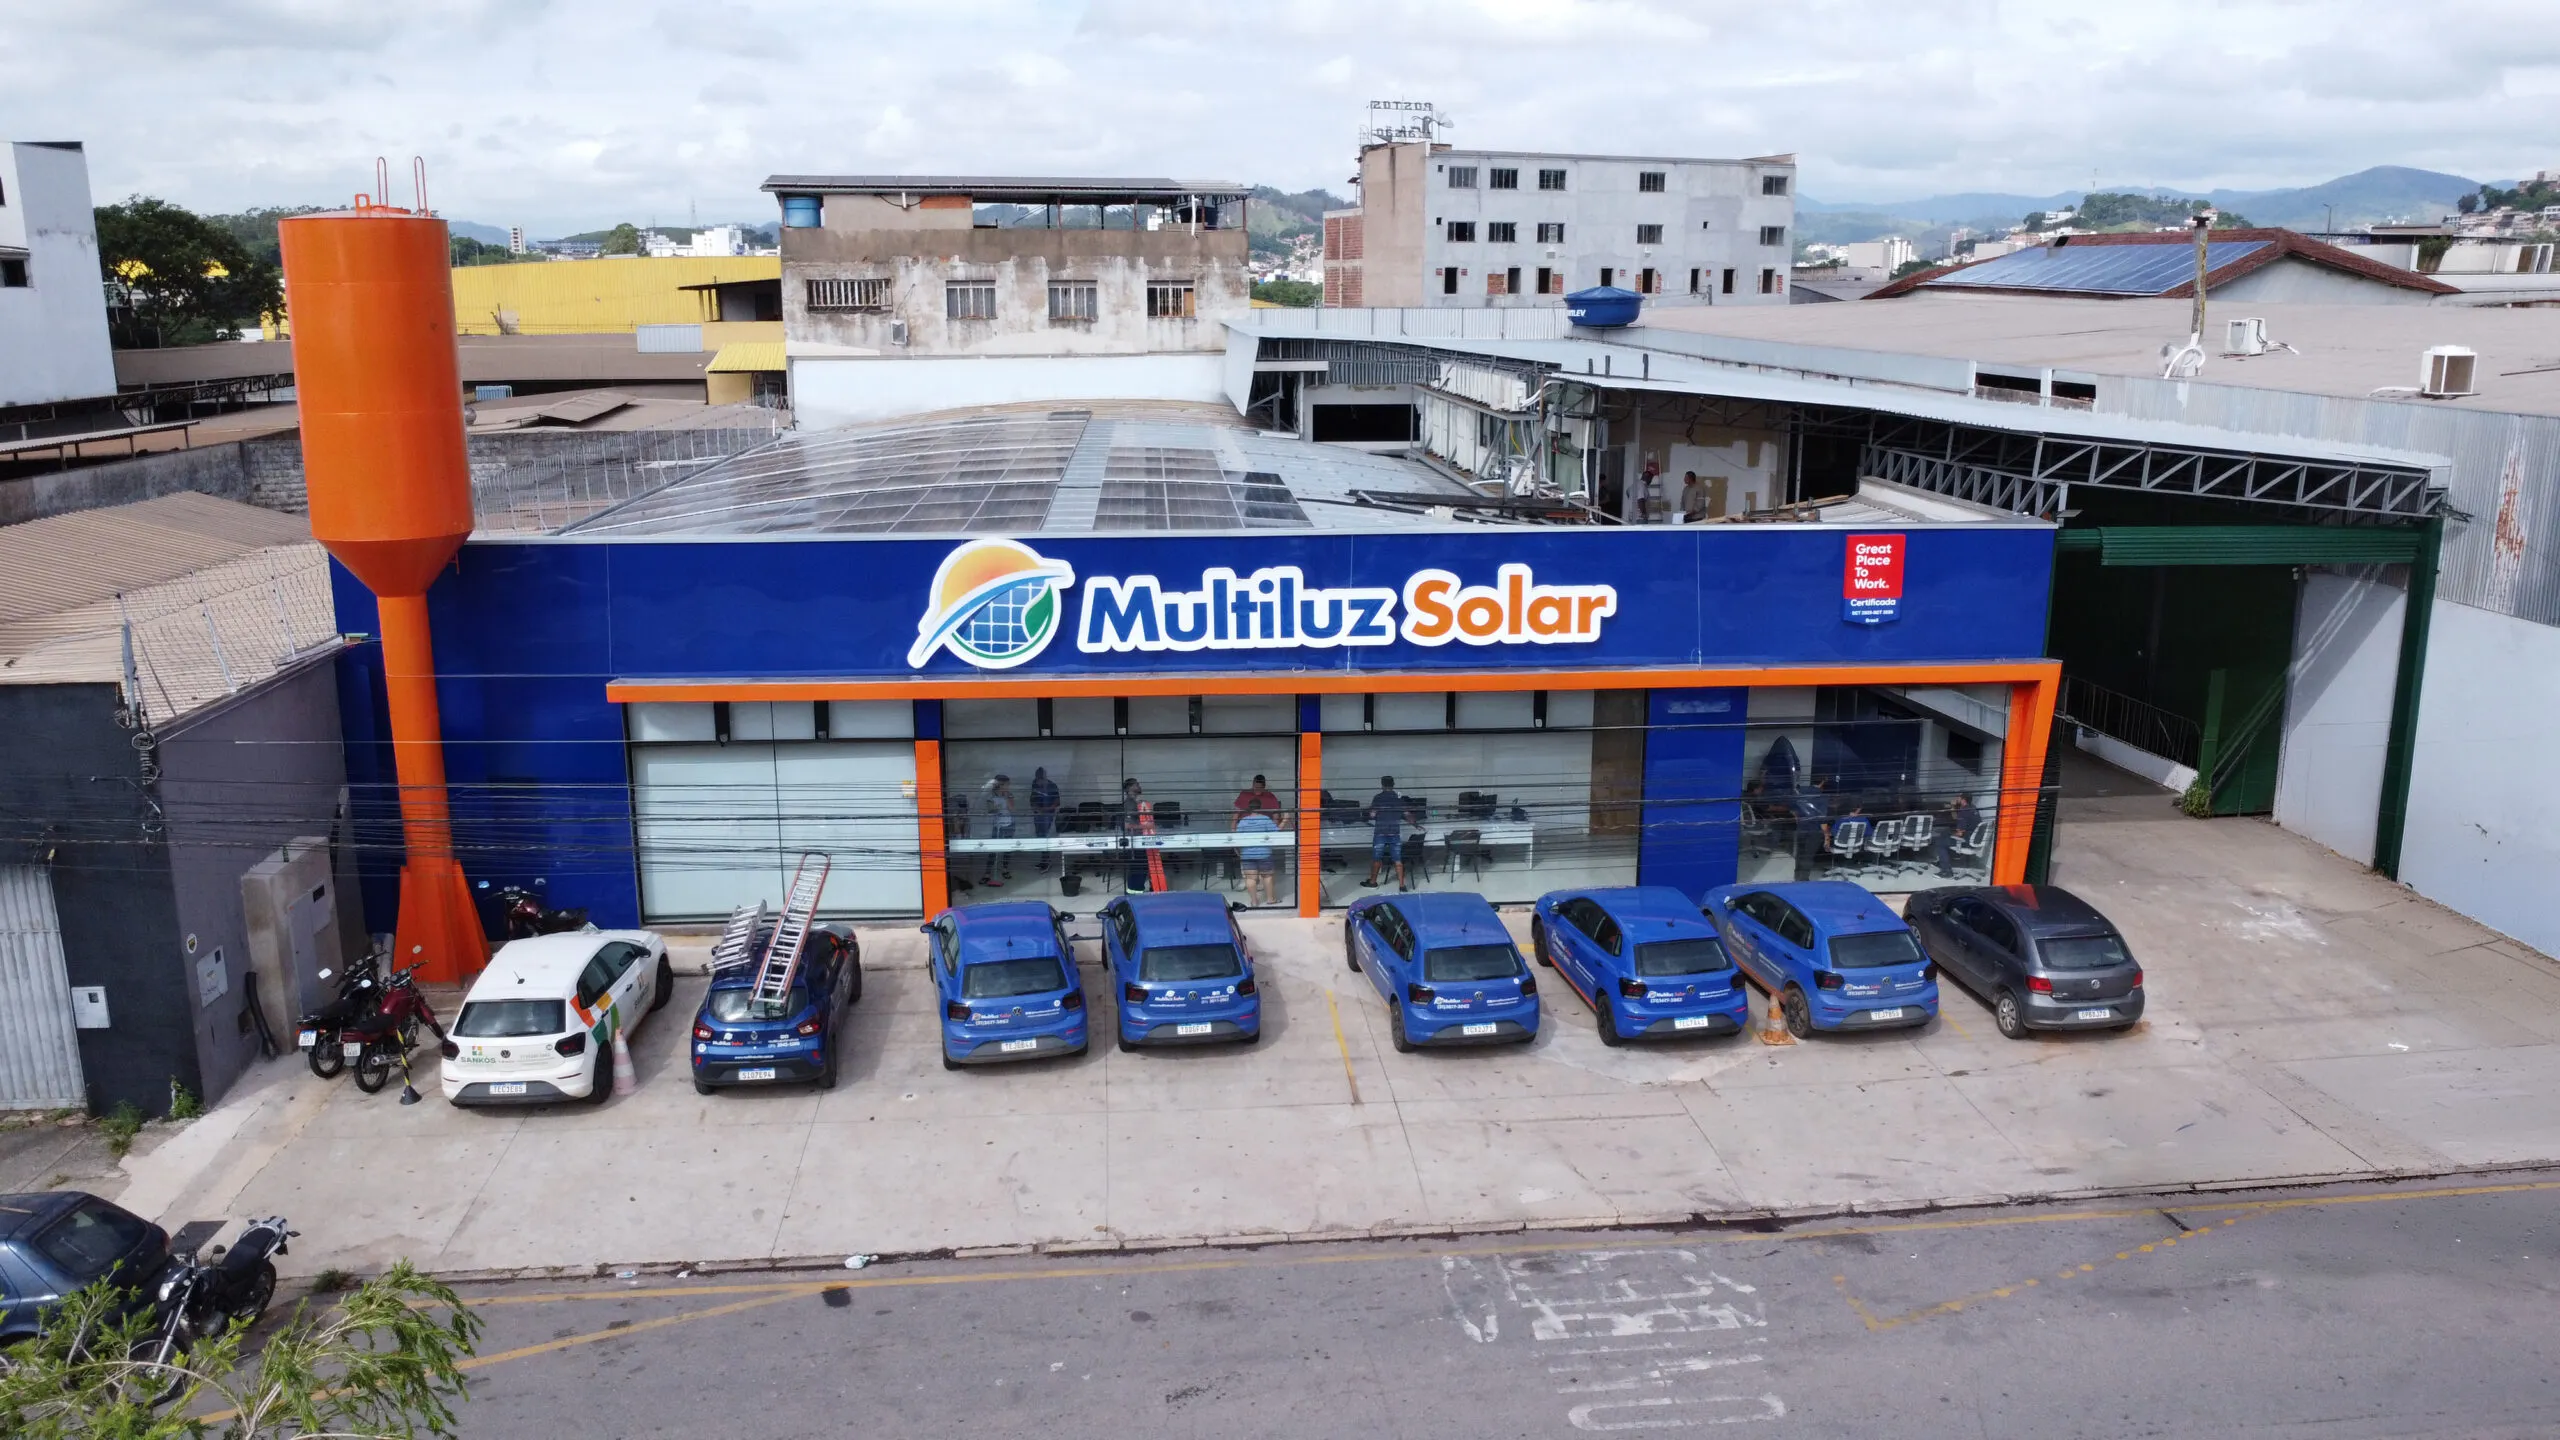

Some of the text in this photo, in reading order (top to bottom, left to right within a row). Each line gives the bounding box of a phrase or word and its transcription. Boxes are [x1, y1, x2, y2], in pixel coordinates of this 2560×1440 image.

[1855, 543, 1892, 555] Great
[1856, 555, 1891, 566] Place
[1854, 566, 1869, 577] To
[1850, 598, 1896, 607] Certificada
[1086, 573, 1610, 644] Multiluz Solar
